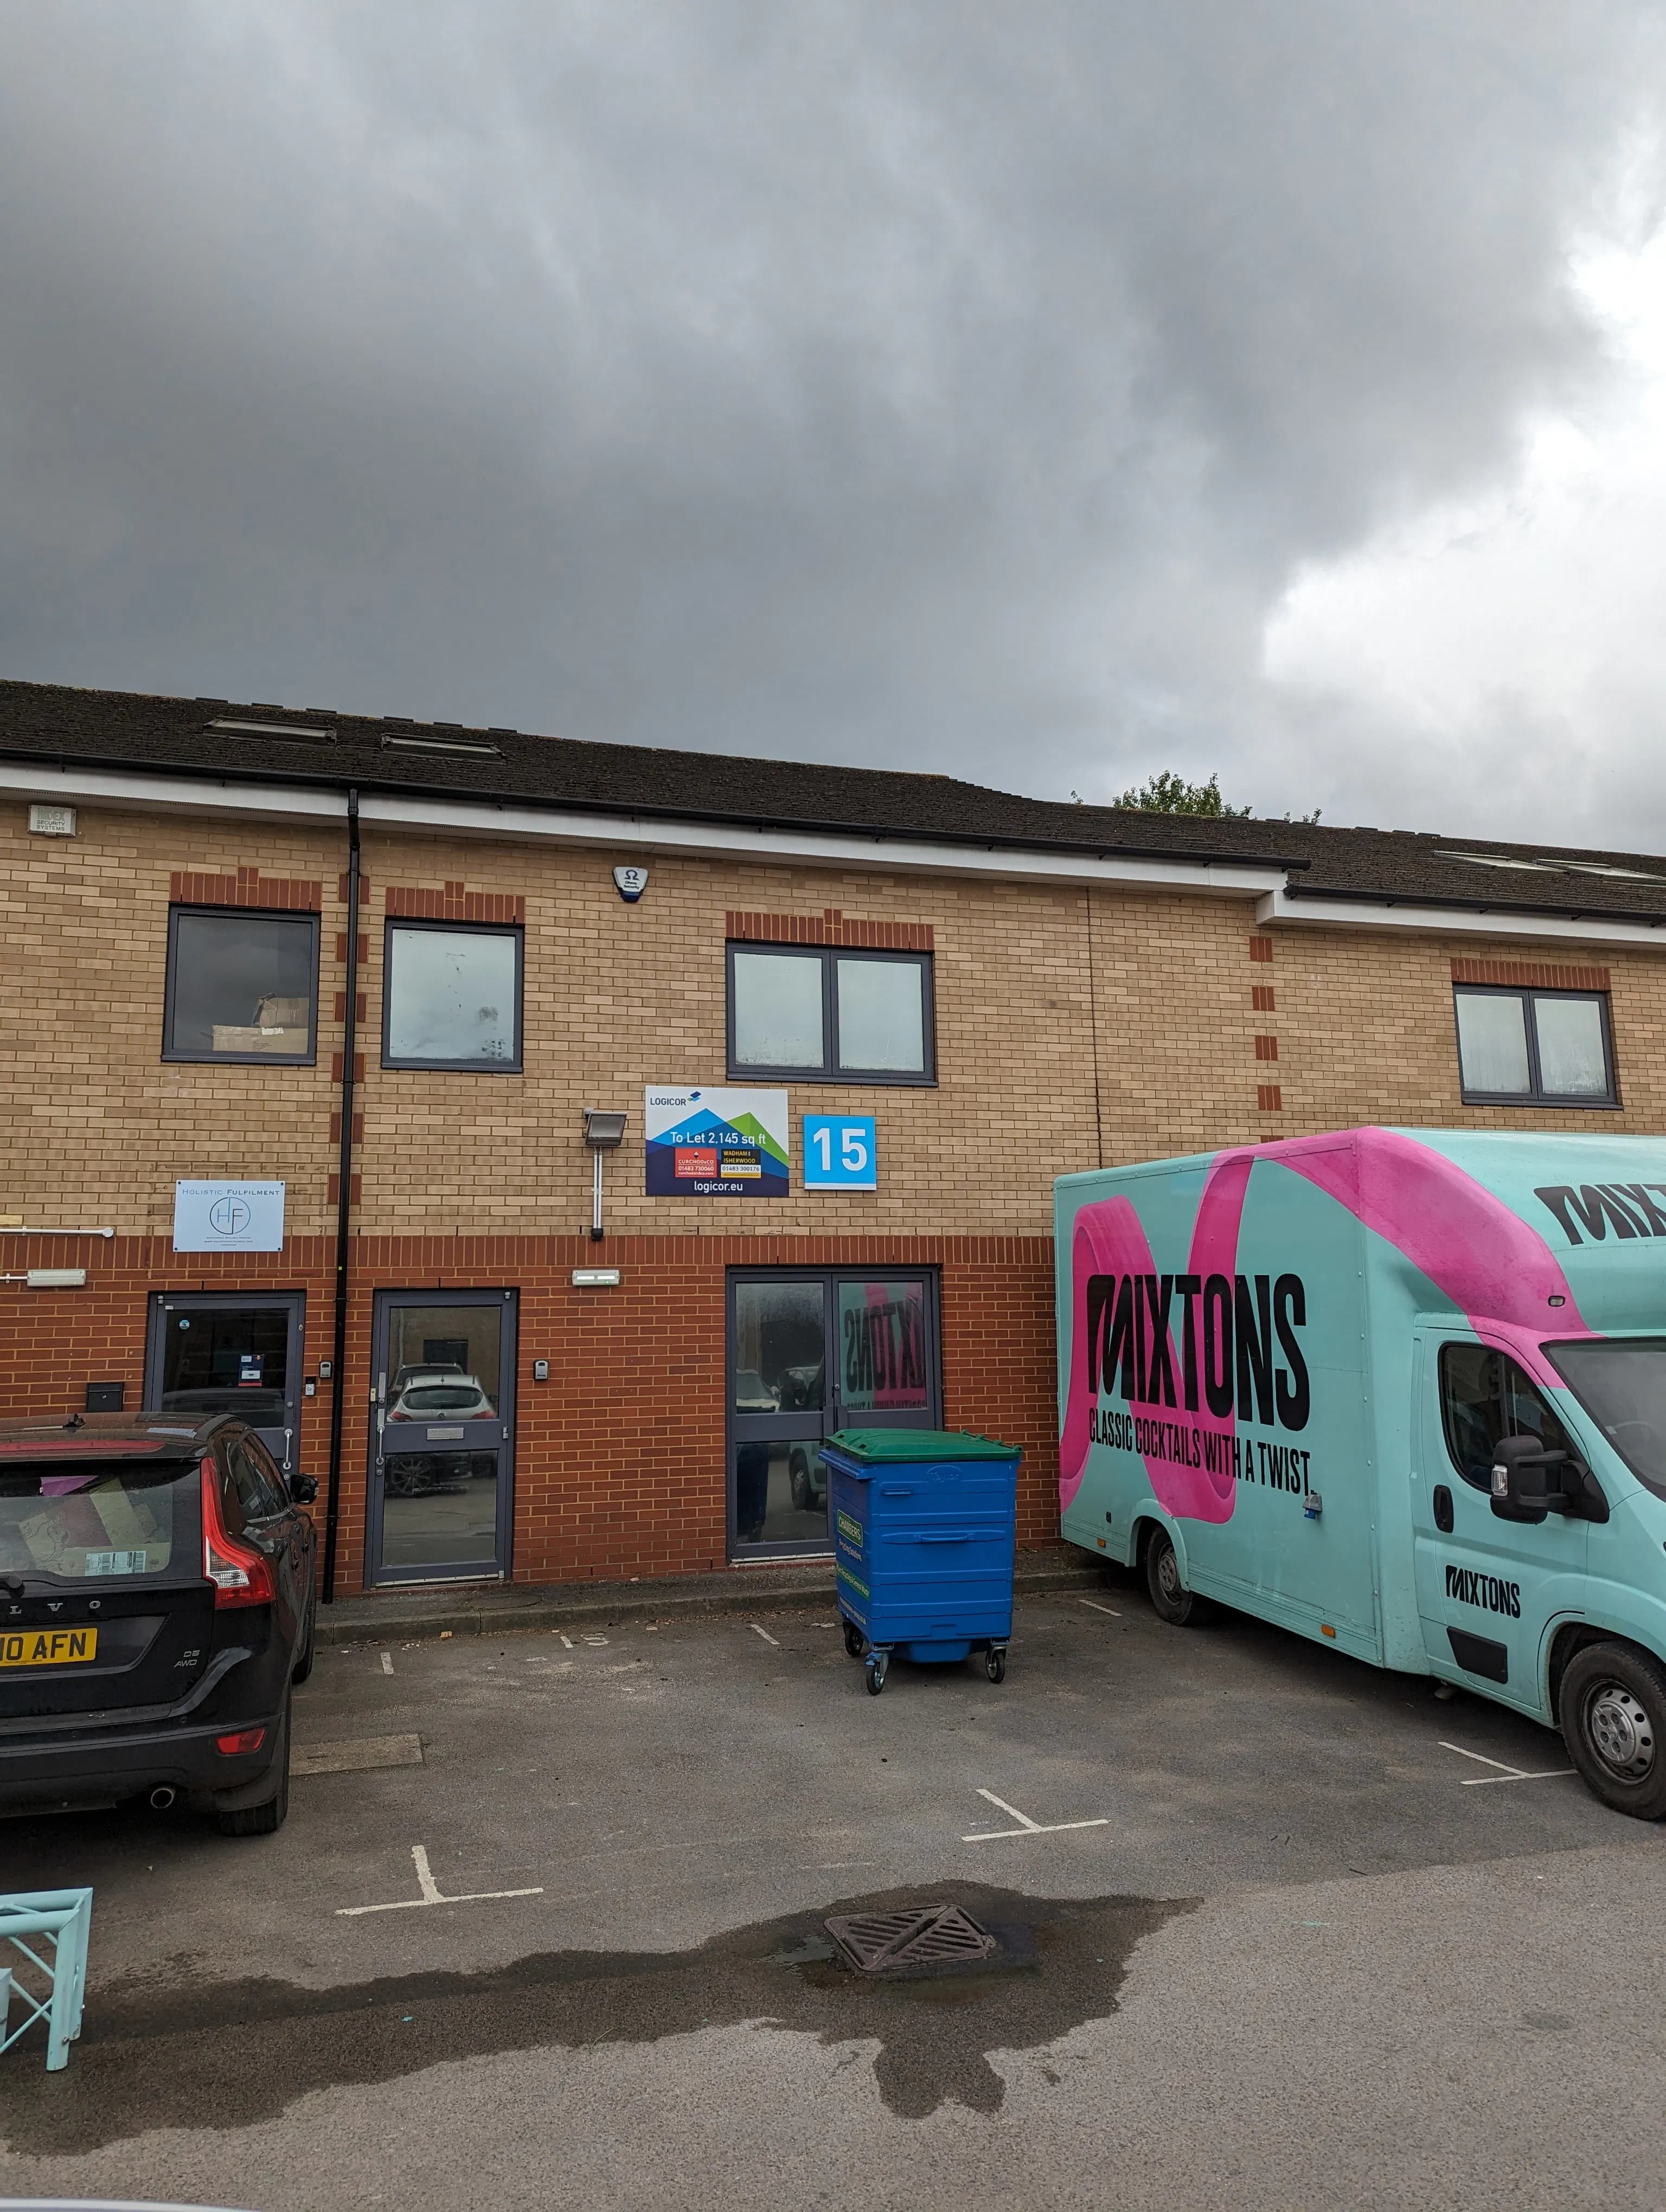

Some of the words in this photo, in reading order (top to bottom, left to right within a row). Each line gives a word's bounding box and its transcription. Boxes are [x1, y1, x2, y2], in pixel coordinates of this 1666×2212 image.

[37, 807, 65, 821] INDEX
[670, 1131, 683, 1143] To
[687, 1132, 705, 1143] Let
[708, 1133, 738, 1144] 2,145
[741, 1135, 754, 1147] sq
[759, 1134, 766, 1144] ft
[813, 1128, 867, 1171] 15
[694, 1181, 743, 1193] logicor.eu
[1087, 1274, 1310, 1431] MIXTONS
[1089, 1407, 1132, 1452] CLASSIC
[1136, 1417, 1200, 1469] COCKTAILS
[1203, 1430, 1241, 1479] WITH
[1245, 1439, 1255, 1483] A
[838, 1516, 861, 1540] CHAMBERS
[1446, 1565, 1521, 1619] MIXTONS
[31, 1632, 87, 1660] AFN
[174, 1660, 197, 1668] AWD
